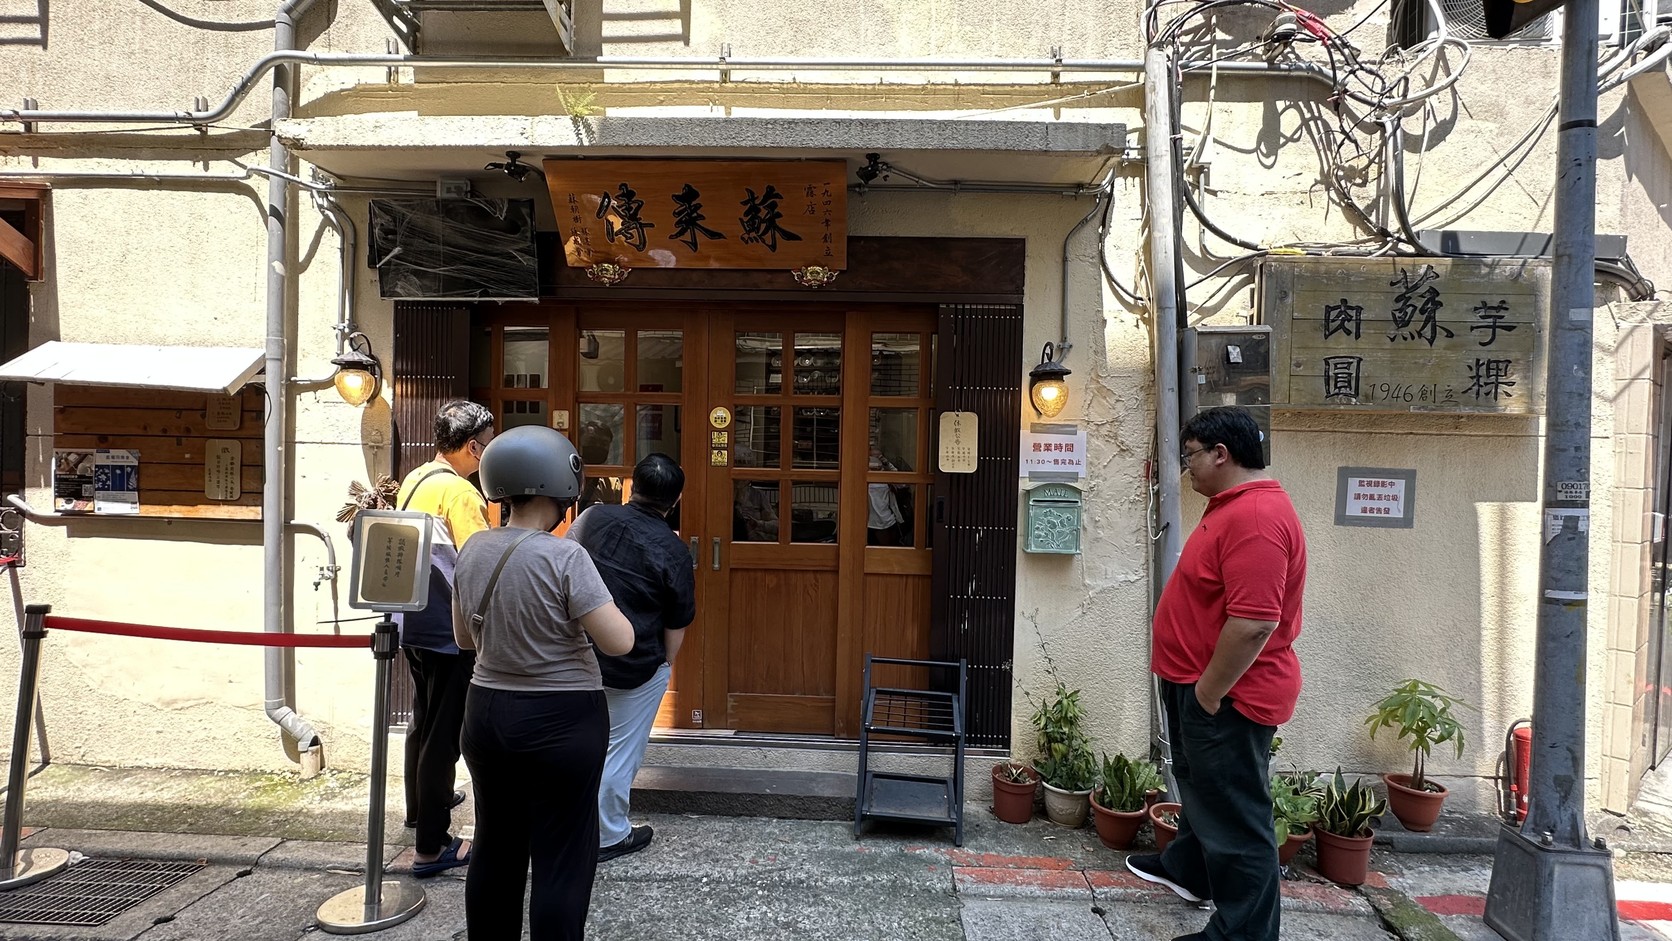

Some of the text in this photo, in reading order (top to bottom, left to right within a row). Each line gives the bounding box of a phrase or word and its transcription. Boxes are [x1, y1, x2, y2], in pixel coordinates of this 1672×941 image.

[821, 182, 834, 257] 一九四六年創立
[1386, 264, 1455, 347] 蘇
[1323, 298, 1364, 400] 肉圓
[1461, 299, 1517, 402] 芋粿
[1032, 442, 1074, 453] 營業時間
[1357, 479, 1396, 489] 監視錄影中
